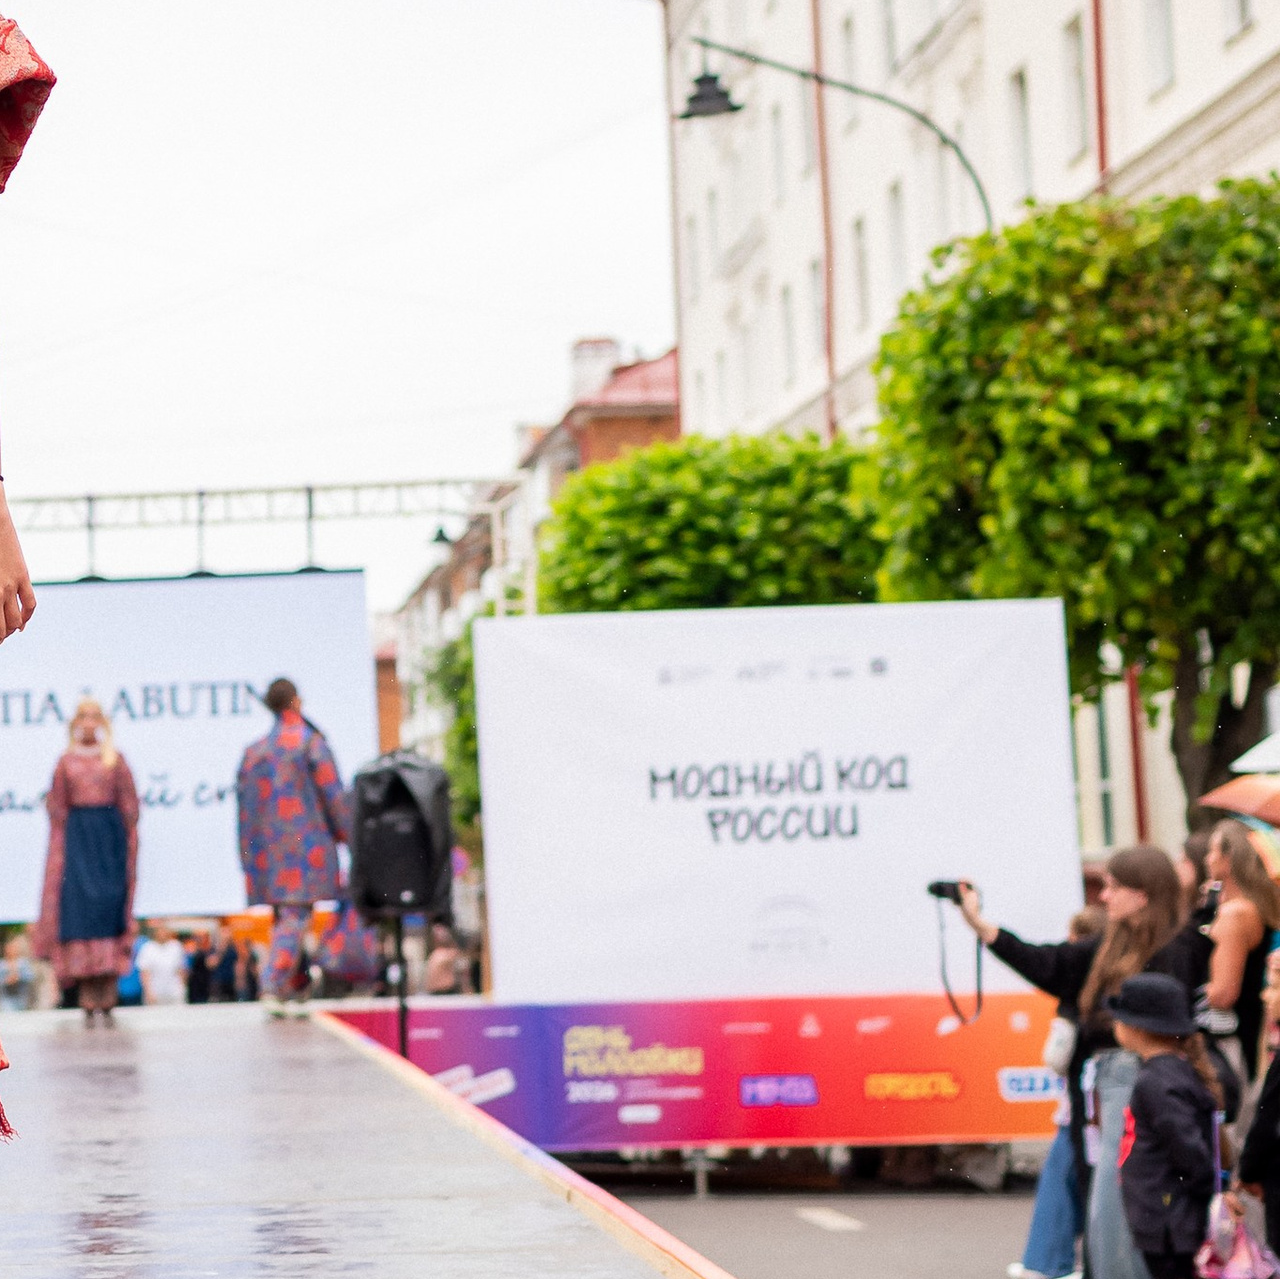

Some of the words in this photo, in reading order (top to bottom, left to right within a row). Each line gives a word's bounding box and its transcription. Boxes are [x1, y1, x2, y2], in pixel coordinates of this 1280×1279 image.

[649, 752, 823, 800] МОДНЫЙ
[836, 755, 908, 791] КОД
[706, 804, 859, 843] РОССИИ
